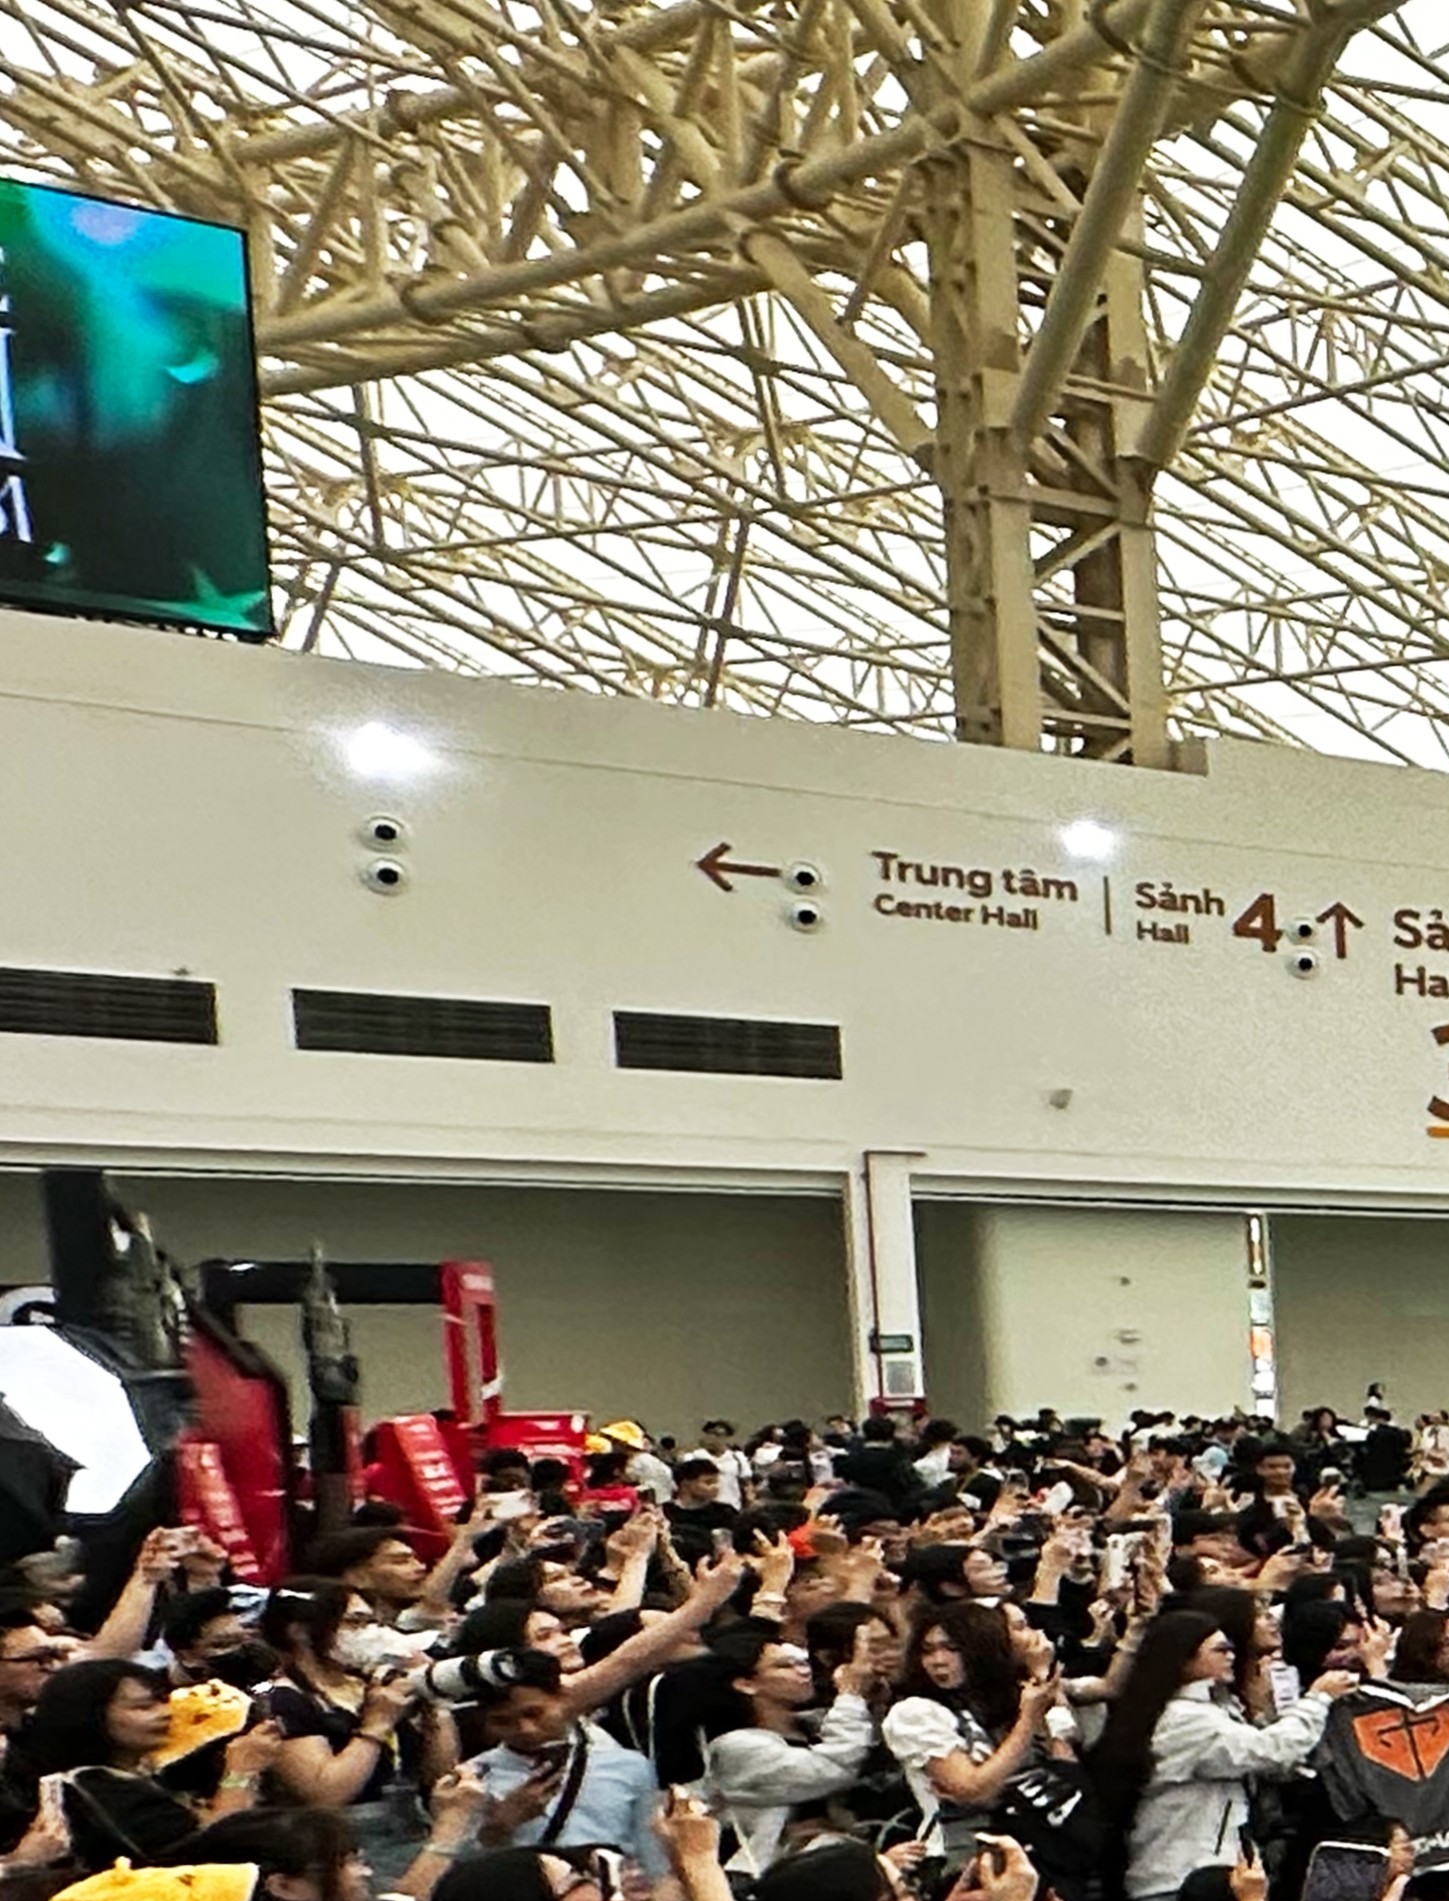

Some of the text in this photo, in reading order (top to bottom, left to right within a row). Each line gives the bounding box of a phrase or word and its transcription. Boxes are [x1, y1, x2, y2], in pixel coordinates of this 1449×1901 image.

[871, 851, 1079, 902] Trung tâm
[873, 893, 1039, 931] Center Hall
[1135, 881, 1284, 953] Sảnh 4
[1136, 920, 1191, 945] Hall
